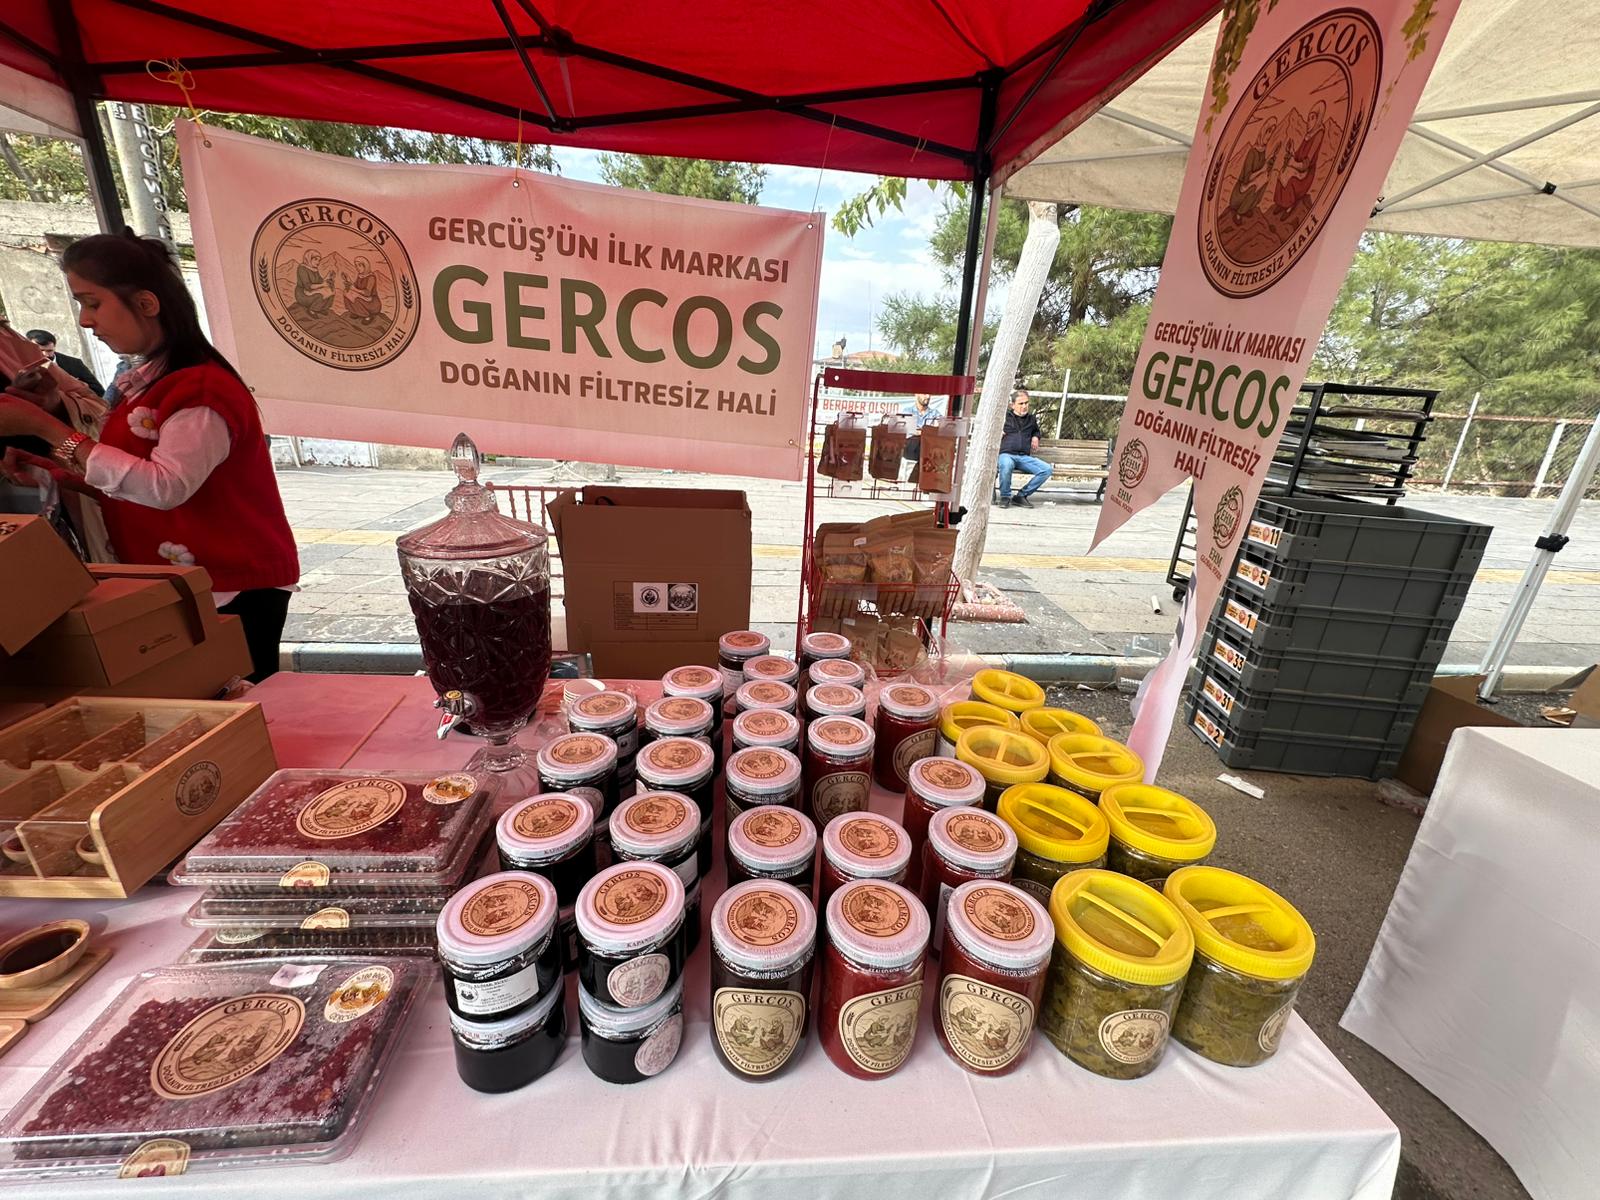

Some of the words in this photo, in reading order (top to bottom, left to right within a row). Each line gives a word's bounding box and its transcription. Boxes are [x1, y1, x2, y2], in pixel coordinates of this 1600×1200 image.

[1252, 21, 1370, 101] GERCOS
[277, 205, 391, 246] GERCOS
[607, 231, 652, 269] İLK
[660, 247, 789, 284] MARKASI
[1204, 229, 1232, 281] DOĞANIN
[1229, 255, 1285, 286] FİLTRESİZ
[1286, 213, 1320, 260] HALİ
[431, 263, 785, 376] GERCOS
[276, 315, 328, 357] DOĞANIN
[330, 346, 387, 363] FİLTRESİZ
[384, 327, 407, 353] HALİ
[1221, 323, 1243, 354] İLK
[1241, 333, 1306, 365] MARKASI
[438, 359, 573, 397] DOĞANIN
[578, 369, 710, 410] FİLTRESİZ
[716, 386, 778, 417] HALİ
[1142, 351, 1292, 439] GERCOS
[823, 398, 866, 411] BERABER
[1134, 408, 1199, 449] DOĞANIN
[1198, 427, 1263, 478] FİLTRESİZ
[1174, 450, 1208, 481] HALİ
[1117, 487, 1133, 504] EHM
[1269, 528, 1281, 546] 11
[1208, 547, 1224, 568] EHM
[1259, 570, 1267, 586] 5
[1246, 614, 1253, 629] 1
[1232, 653, 1245, 672] 33
[1220, 692, 1231, 711] 31
[1212, 728, 1221, 744] 2
[345, 779, 399, 794] GERCOS
[827, 775, 866, 785] GERCOS
[600, 872, 641, 895] GERCOS
[521, 884, 538, 917] GERCOS
[966, 888, 990, 915] GERCOS
[771, 908, 797, 942] GERCOS
[891, 899, 908, 933] GERCOS
[223, 999, 296, 1016] GERCOS
[731, 993, 795, 1008] GERCOS
[966, 983, 1028, 1016] GERCOS
